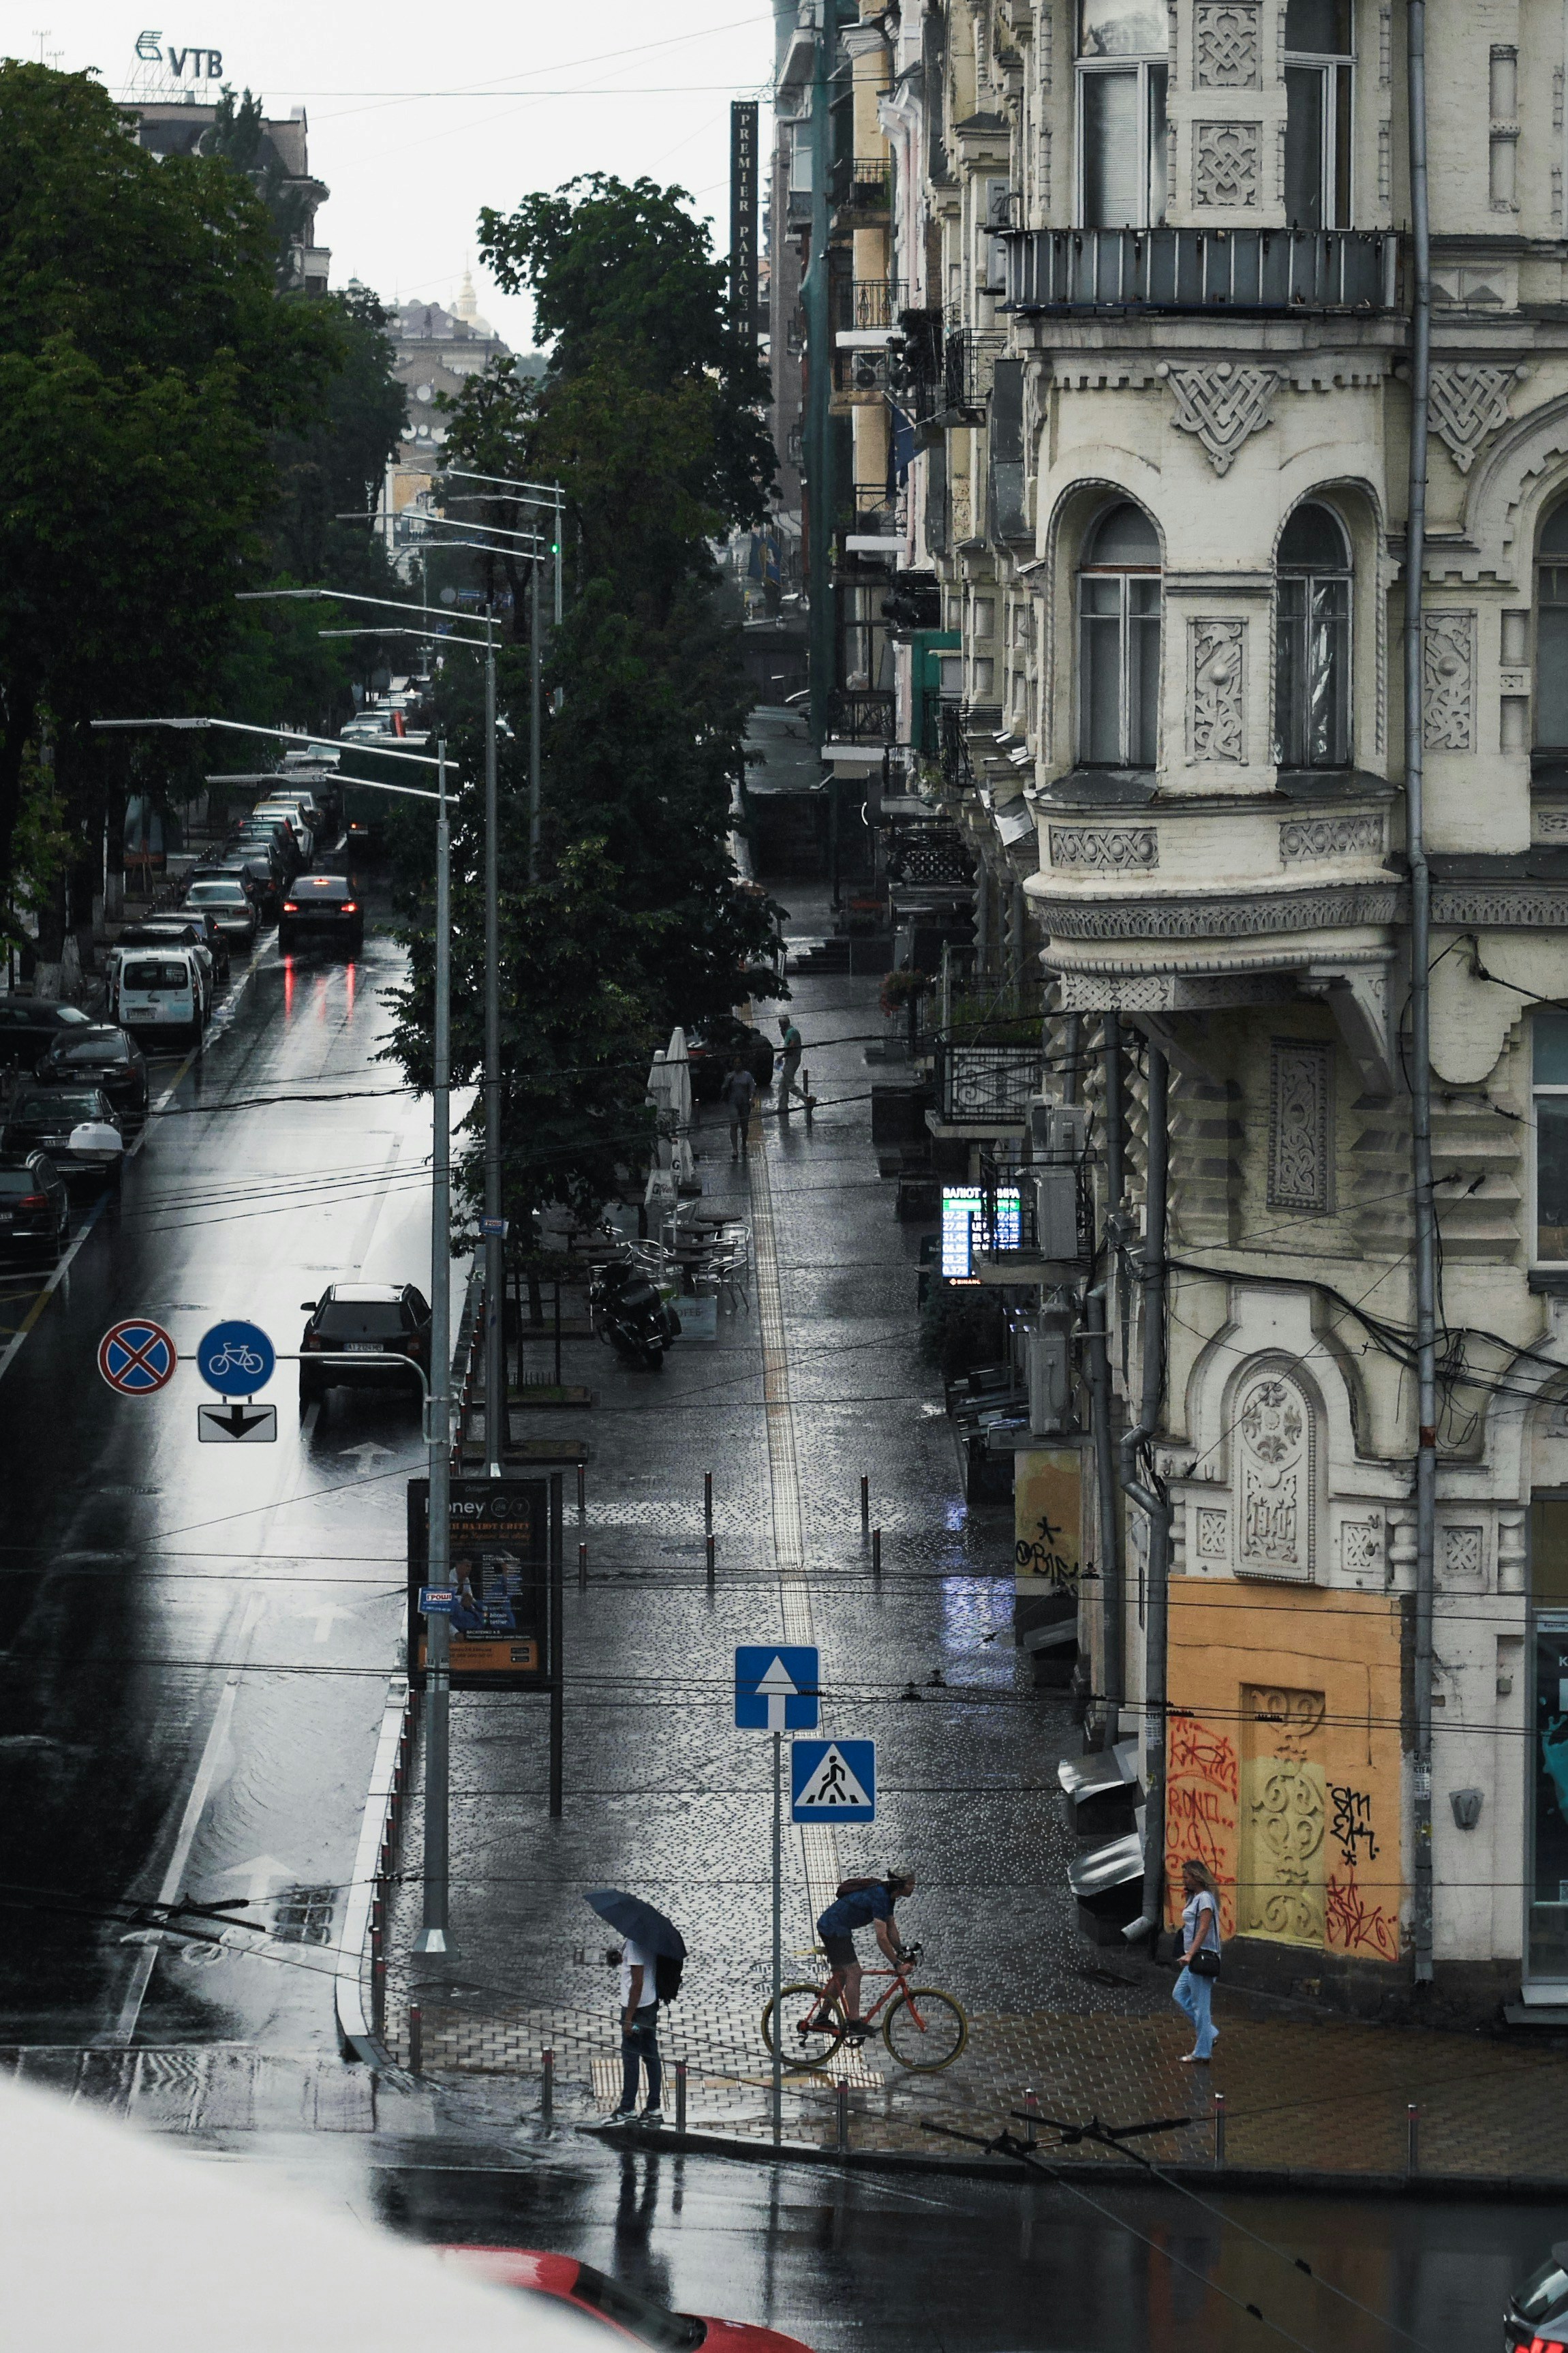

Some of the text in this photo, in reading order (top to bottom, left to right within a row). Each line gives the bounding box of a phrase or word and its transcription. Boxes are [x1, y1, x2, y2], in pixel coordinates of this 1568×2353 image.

[168, 47, 223, 78] VTB
[738, 114, 750, 211] PREMIER
[942, 1232, 968, 1242] 31.45
